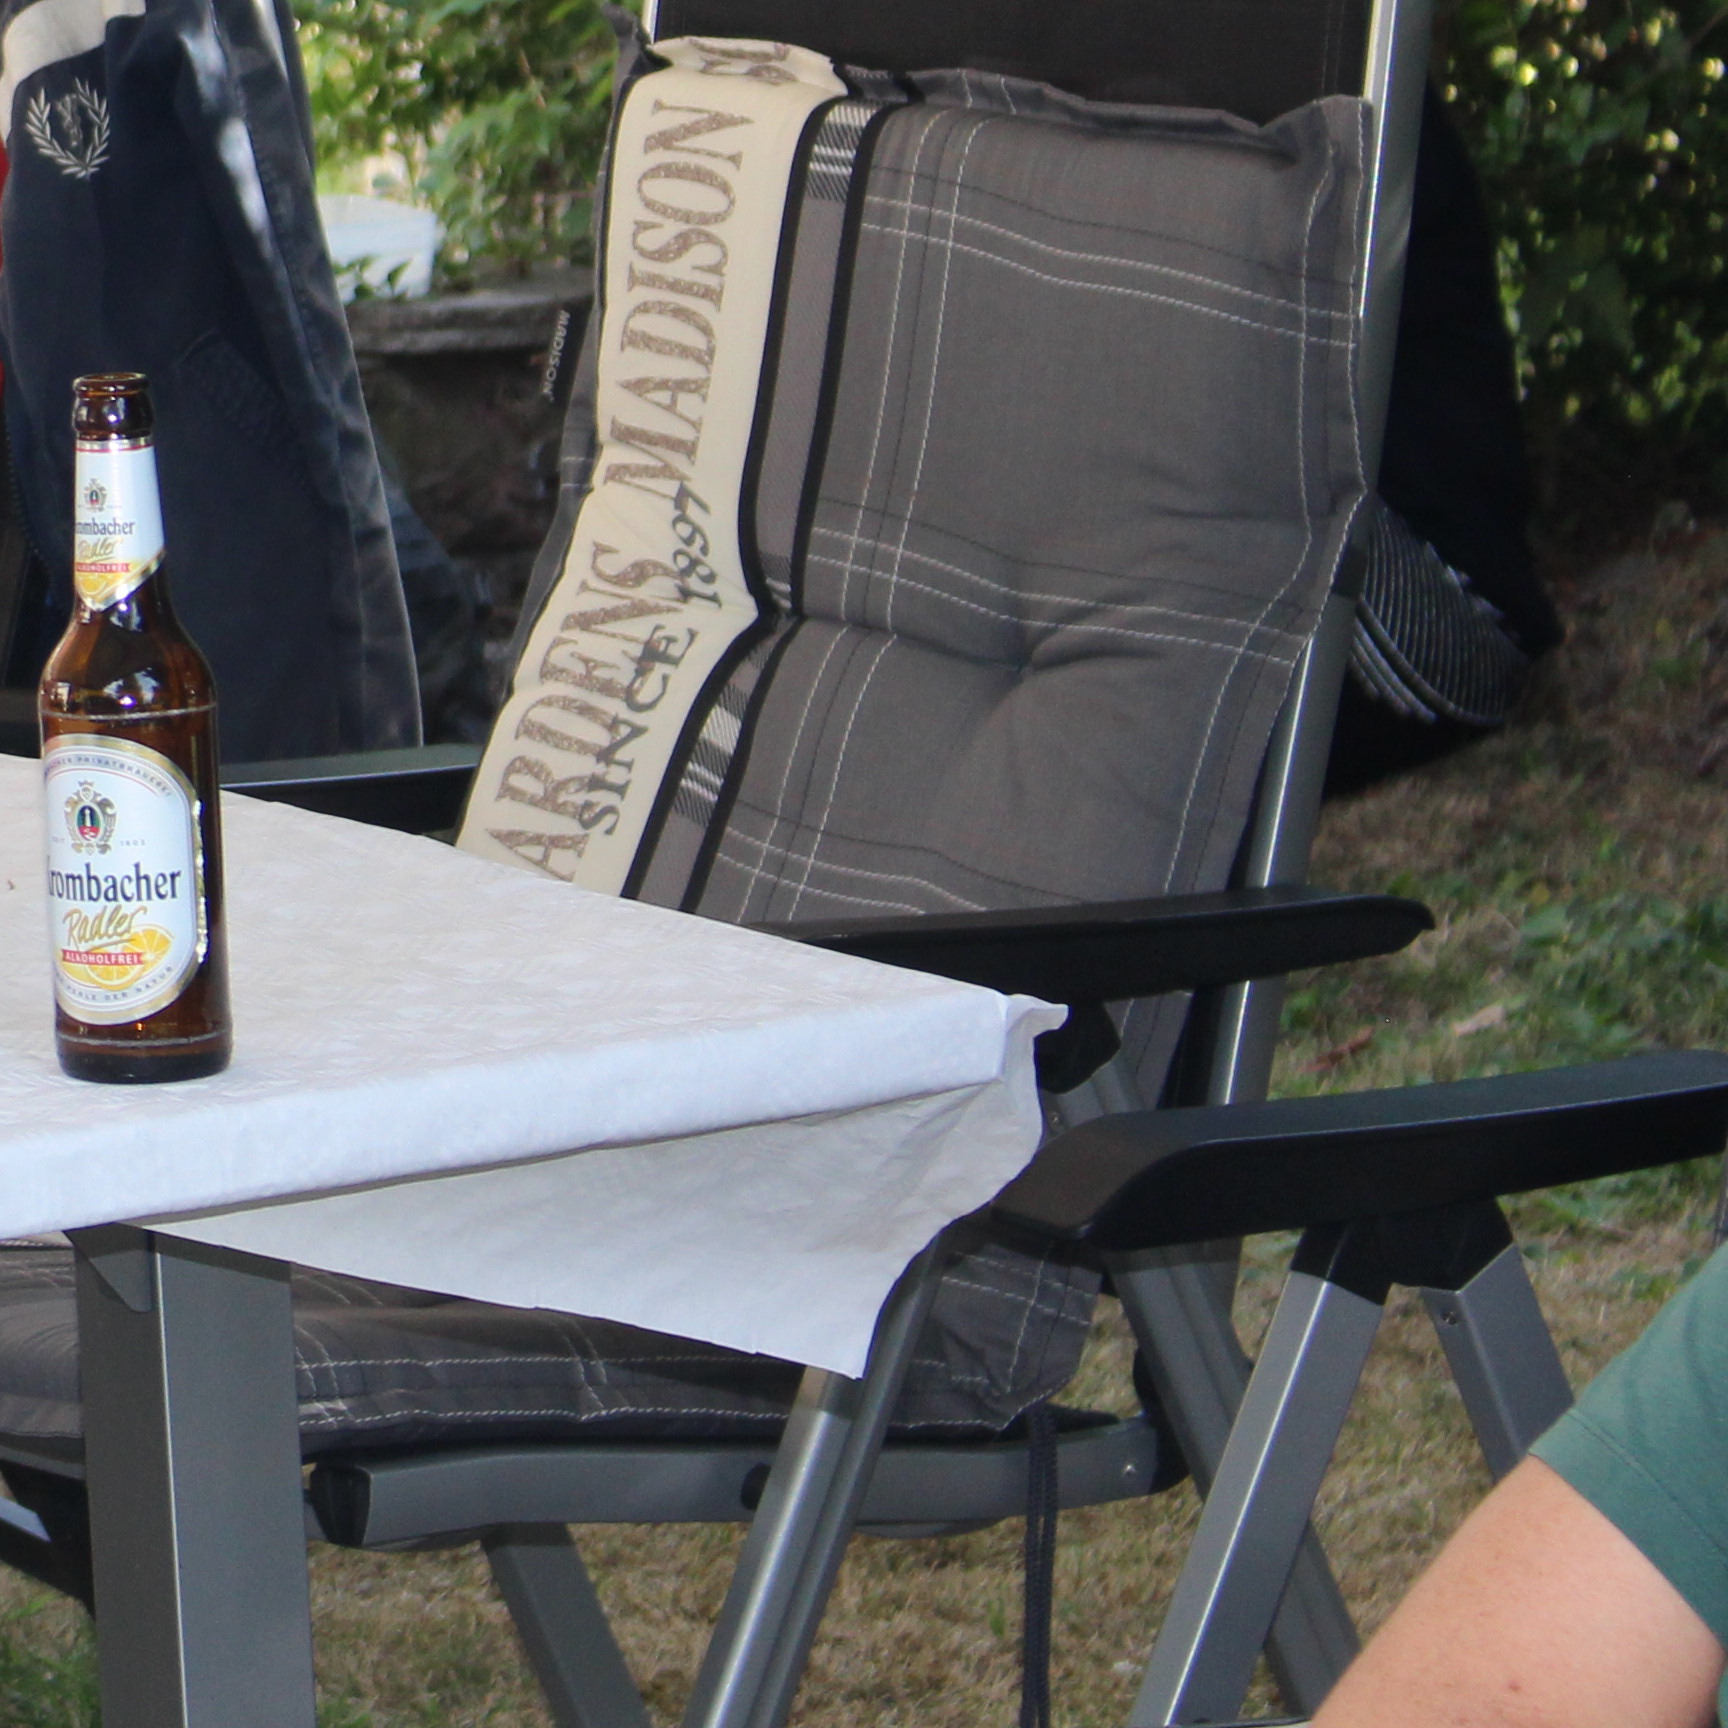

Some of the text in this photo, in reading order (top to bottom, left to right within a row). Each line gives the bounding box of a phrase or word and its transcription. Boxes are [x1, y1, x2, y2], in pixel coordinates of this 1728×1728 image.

[603, 98, 755, 501] MADISON
[578, 481, 723, 838] SINCE 1897
[62, 904, 148, 948] Radler
[63, 951, 140, 965] ALKOHOLFREI
